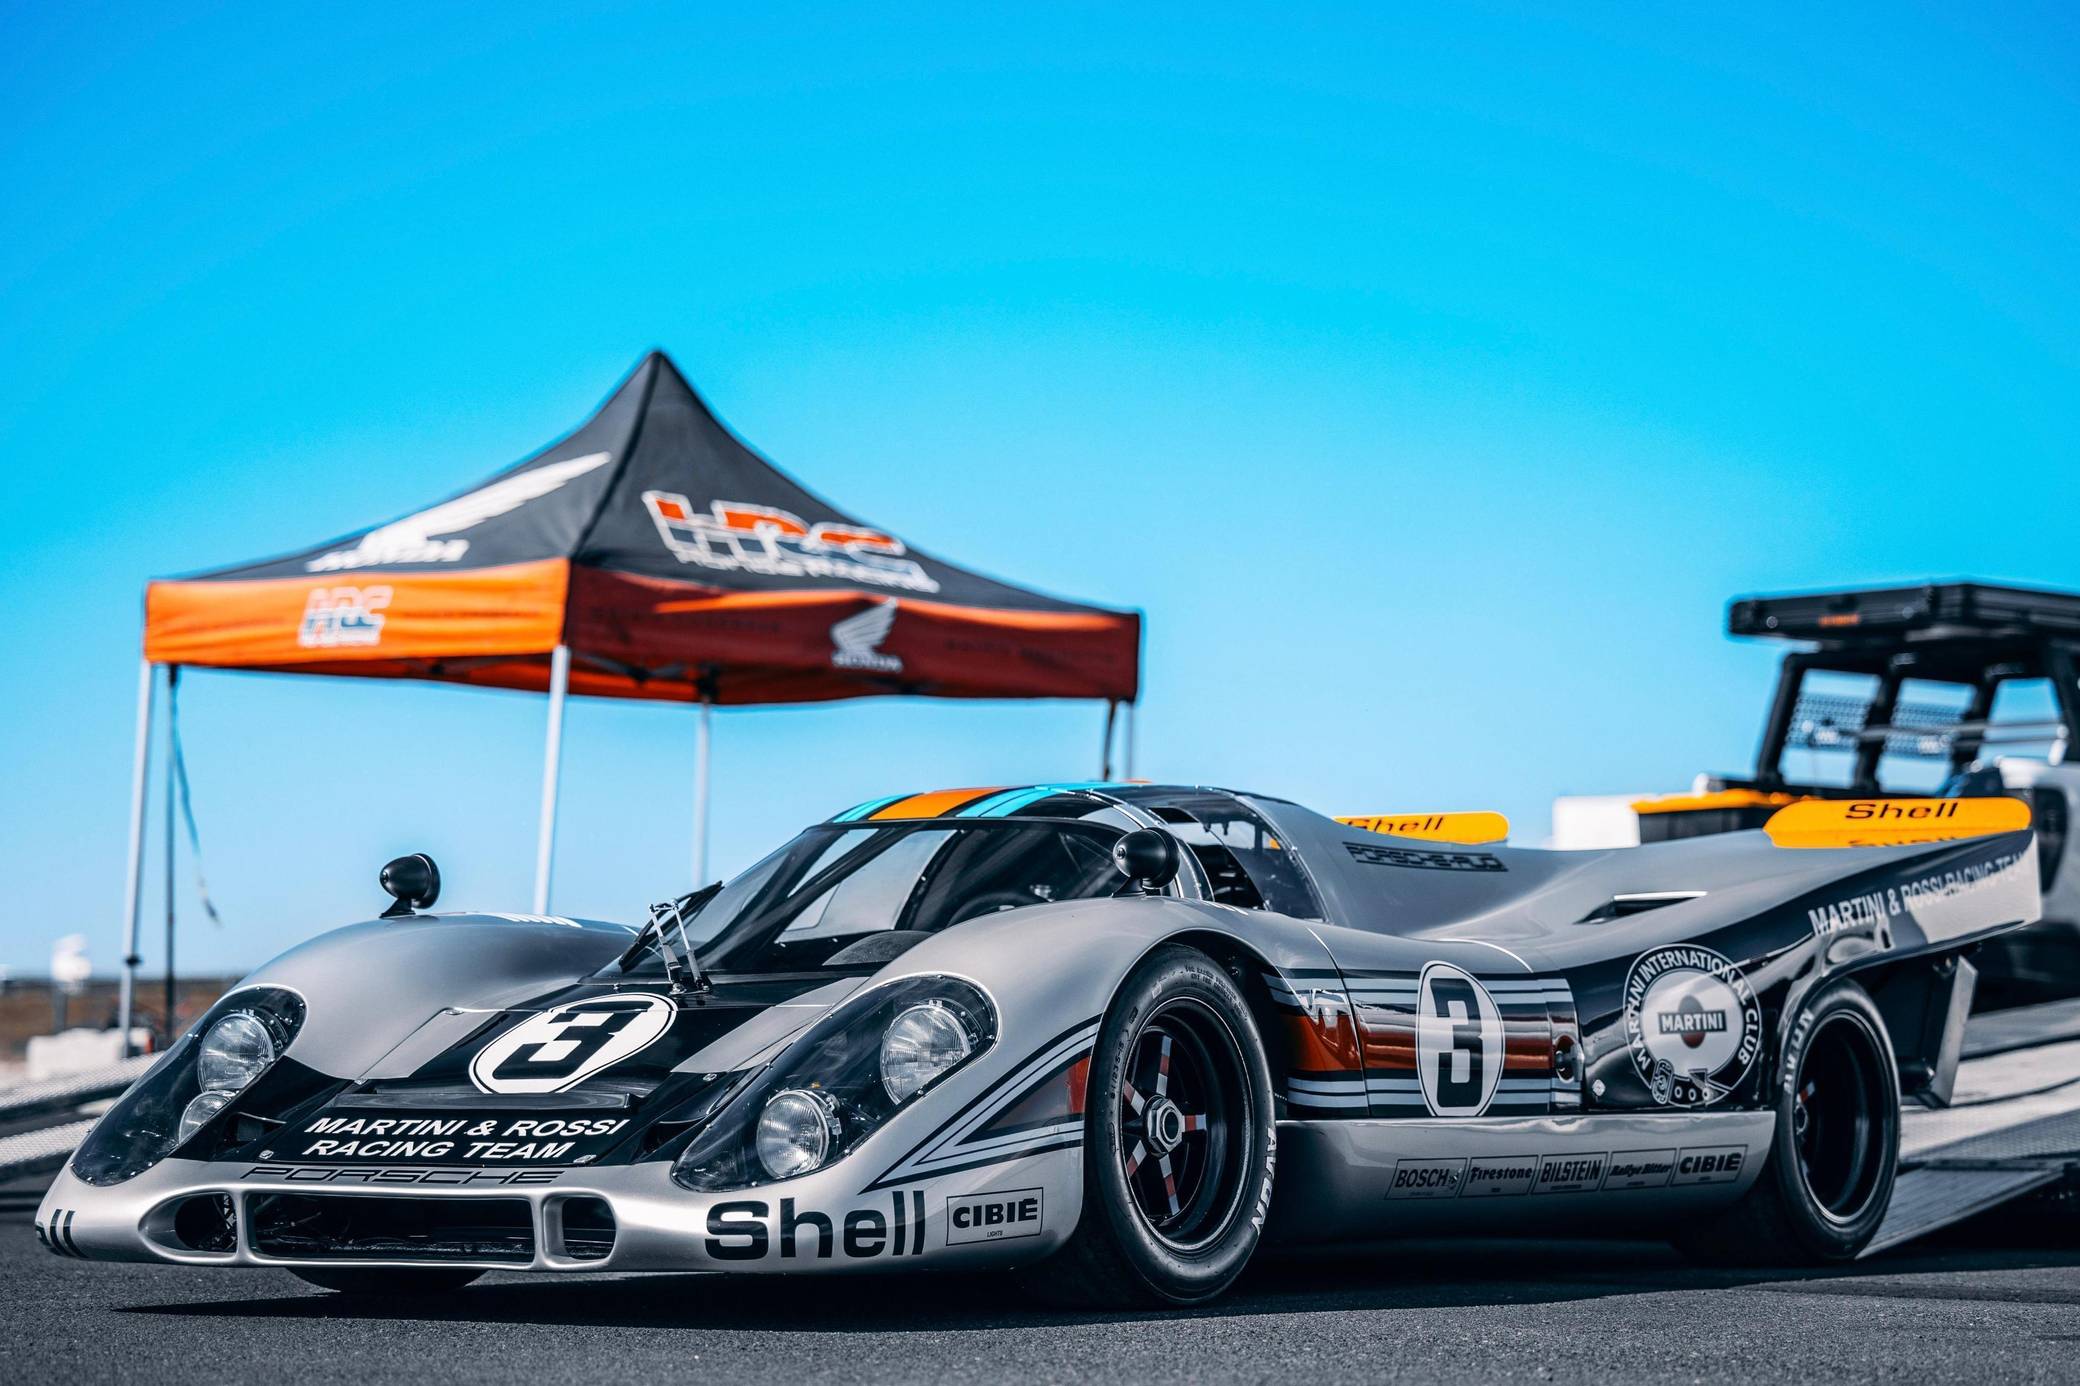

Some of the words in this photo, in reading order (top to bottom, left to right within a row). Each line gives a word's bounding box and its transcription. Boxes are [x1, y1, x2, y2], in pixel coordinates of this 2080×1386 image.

[1845, 802, 1959, 819] Shell
[1808, 891, 1888, 937] MARTINI
[1888, 888, 1901, 916] &
[1639, 949, 1752, 1006] INTERNATIONAL
[1738, 1008, 1759, 1066] CLUB
[1662, 1011, 1724, 1033] MARTINI
[491, 1000, 655, 1080] 3
[1430, 978, 1483, 1107] 3
[303, 1117, 469, 1136] MARTINI
[464, 1119, 498, 1137] &
[501, 1119, 631, 1137] ROSSI
[301, 1139, 456, 1158] RACING
[463, 1141, 577, 1159] TEAM
[240, 1165, 566, 1185] PORSCHE
[1394, 1168, 1450, 1188] BOSCH
[1469, 1165, 1533, 1184] Firestone
[1540, 1159, 1603, 1184] BILSTEIN
[704, 1190, 926, 1261] Shell
